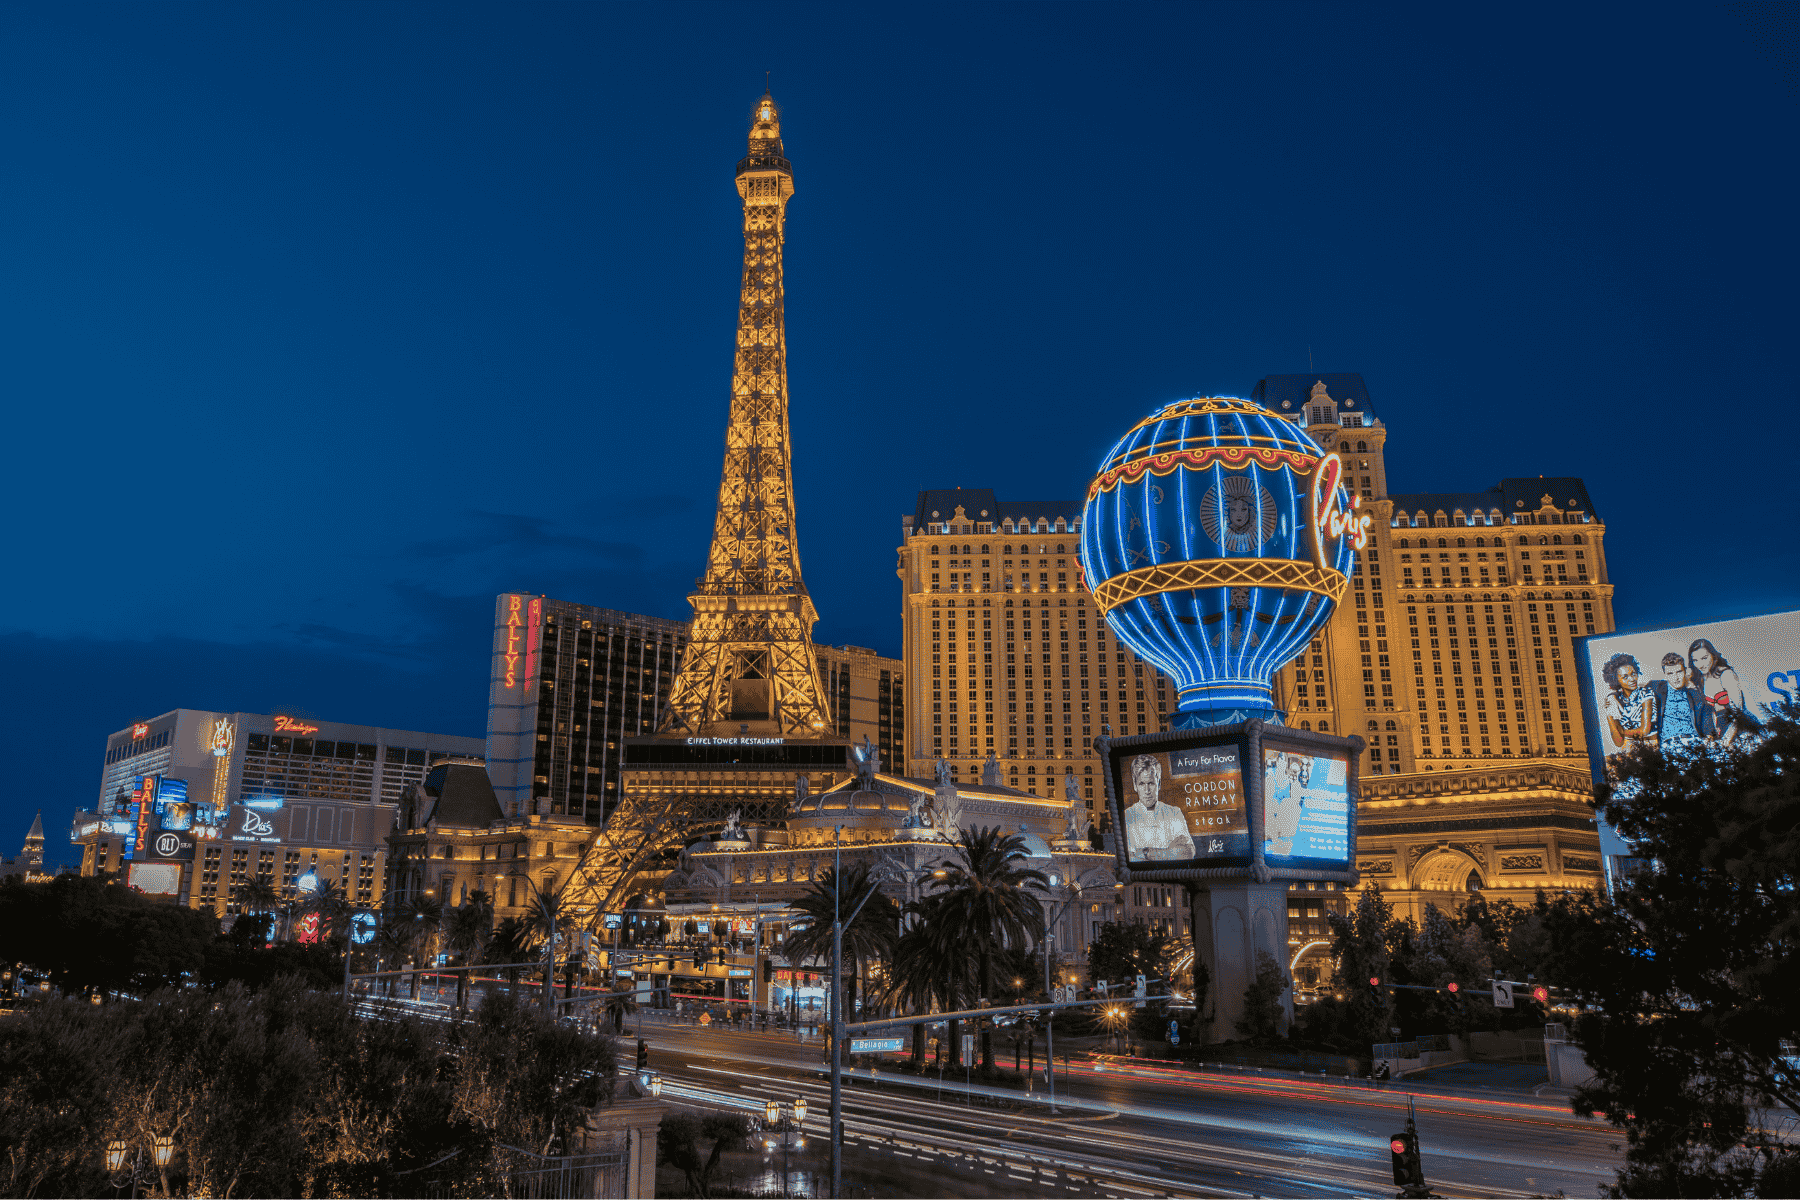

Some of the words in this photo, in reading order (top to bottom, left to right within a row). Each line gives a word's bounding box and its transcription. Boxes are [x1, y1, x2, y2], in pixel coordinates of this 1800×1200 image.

[1313, 453, 1371, 569] Paris
[687, 737, 711, 745] EIFFEL
[713, 737, 738, 745] TOWER
[740, 737, 784, 745] RESTAURANT
[1177, 758, 1184, 767] A
[1184, 757, 1199, 767] Fury
[1200, 755, 1212, 765] For
[1213, 754, 1236, 763] Flavor
[1184, 780, 1236, 794] GORDON
[1185, 793, 1236, 807] RAMSAY
[1195, 815, 1231, 826] steak
[160, 838, 176, 851] BLT
